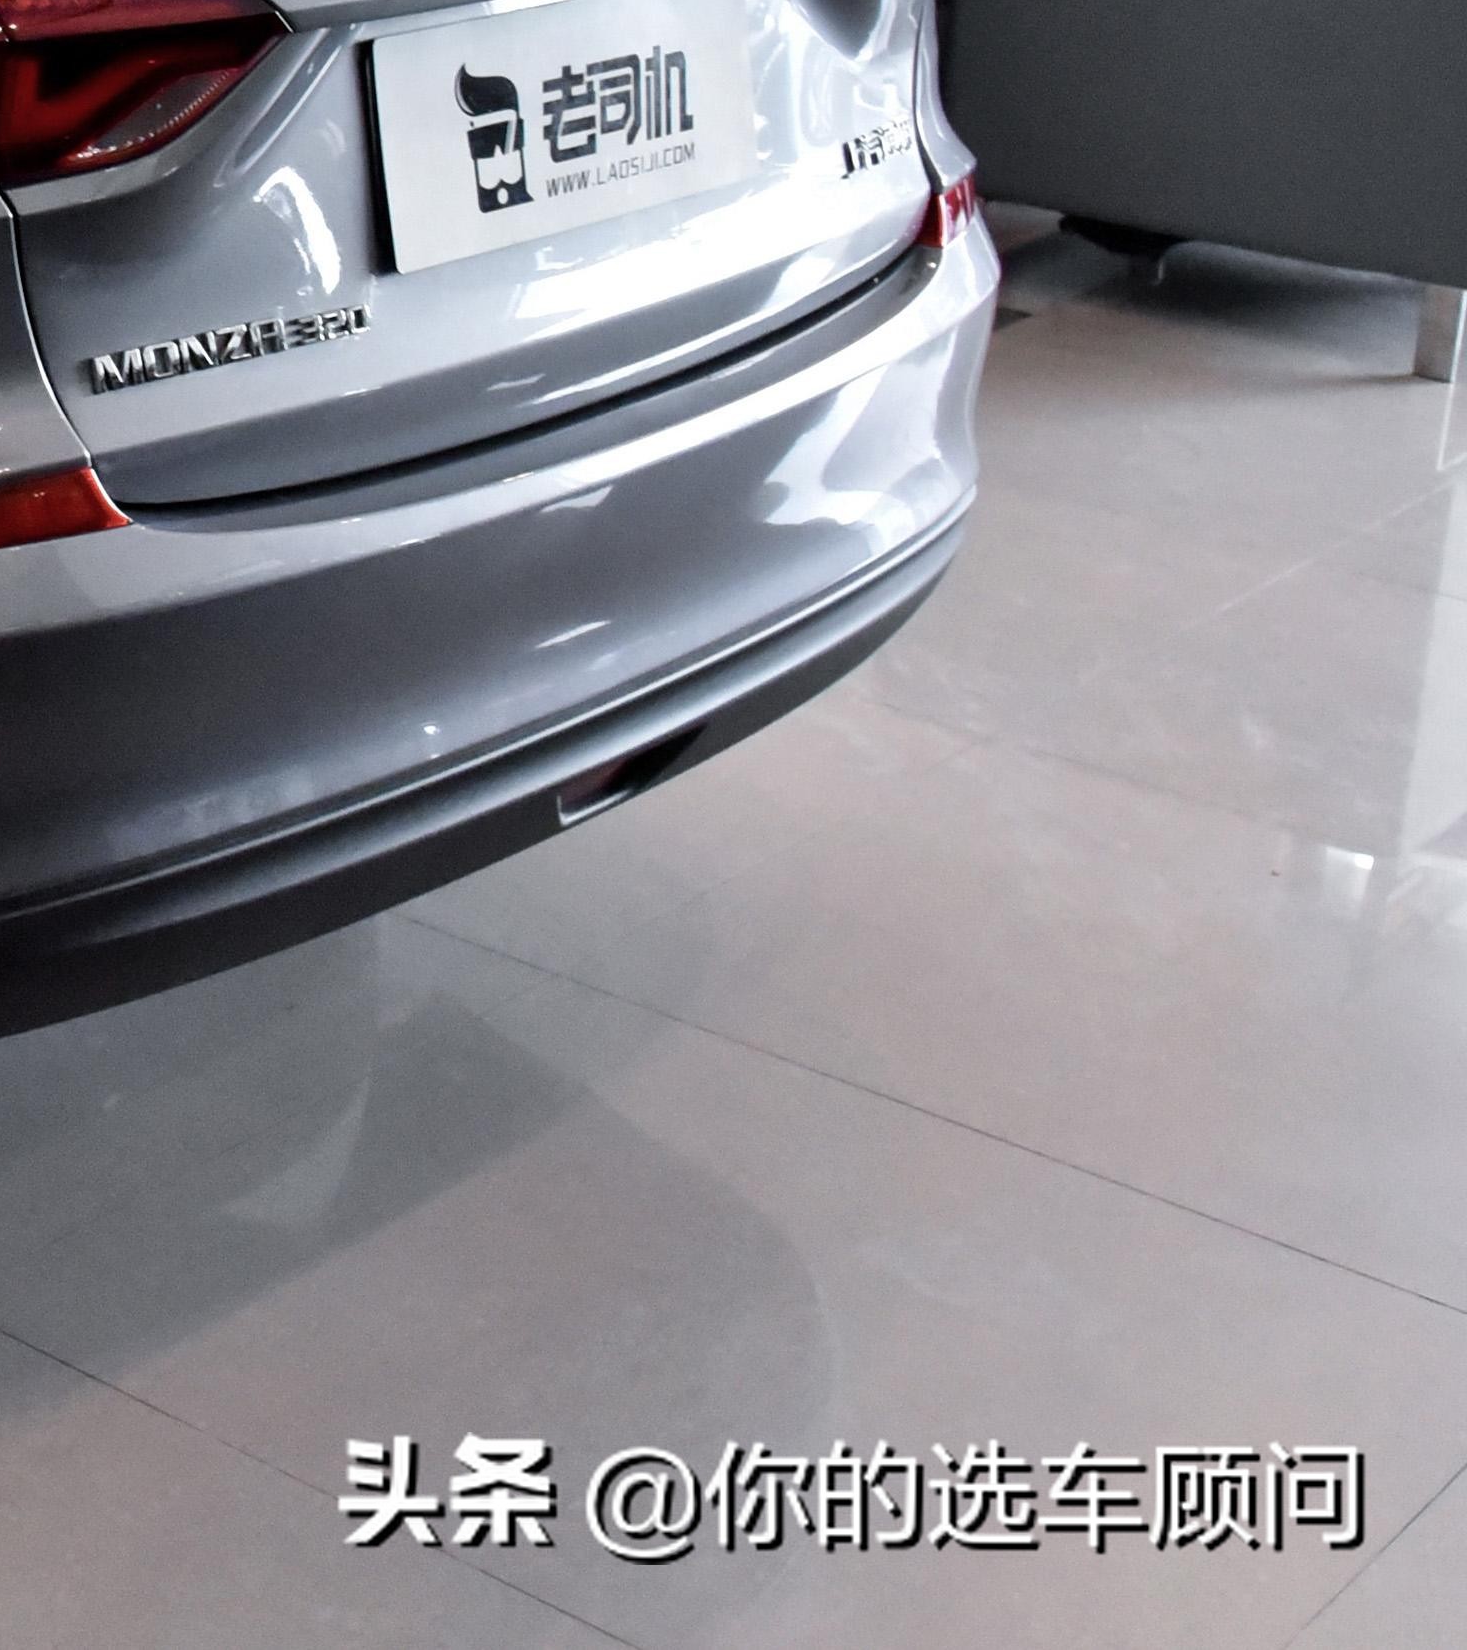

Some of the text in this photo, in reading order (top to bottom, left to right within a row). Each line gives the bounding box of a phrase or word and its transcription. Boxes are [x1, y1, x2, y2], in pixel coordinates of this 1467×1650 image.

[542, 45, 694, 163] 老司机
[545, 142, 697, 198] WWW.LAOSIJI.COM
